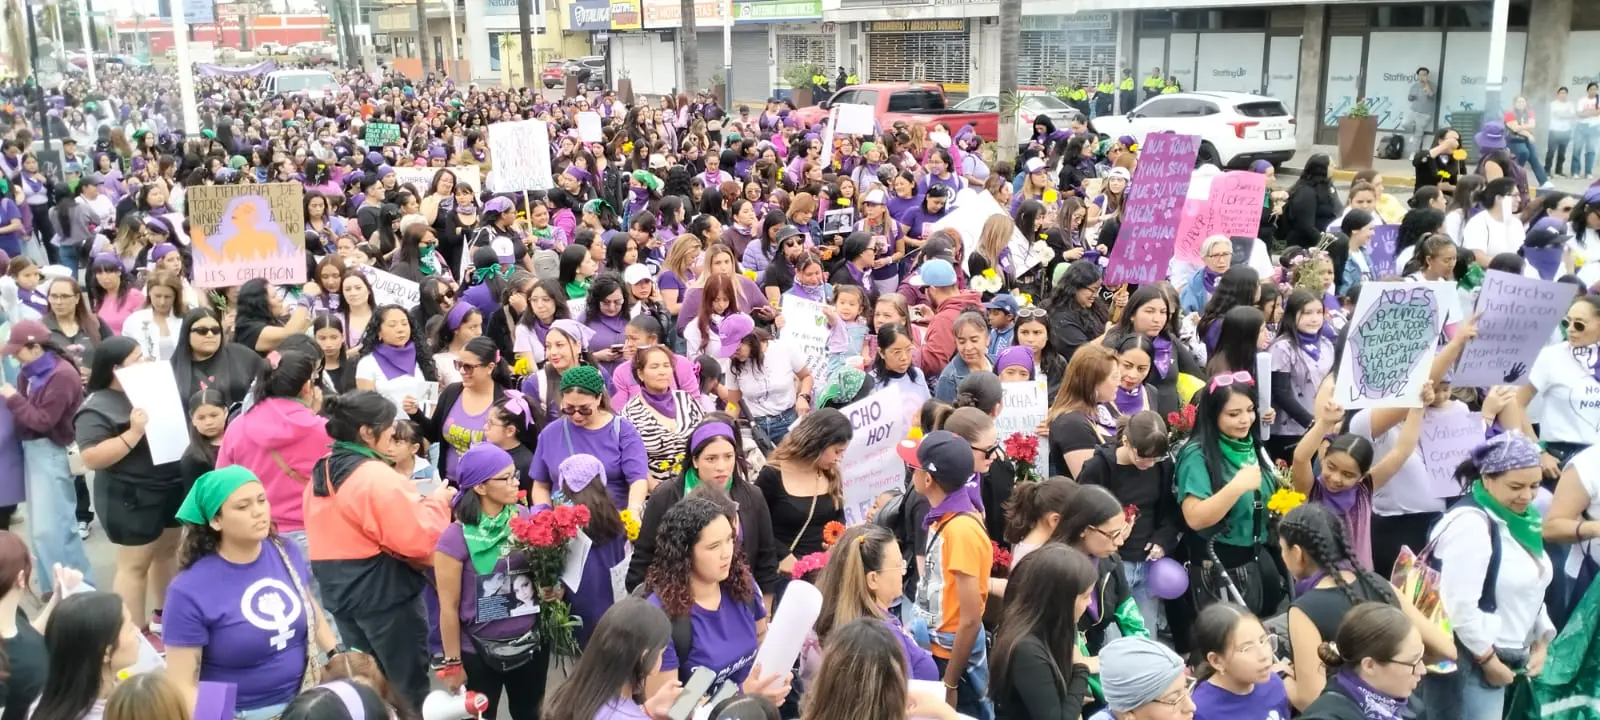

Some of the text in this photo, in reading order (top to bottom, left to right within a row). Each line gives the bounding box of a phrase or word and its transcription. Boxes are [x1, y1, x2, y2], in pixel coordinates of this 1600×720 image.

[660, 5, 713, 18] MOTOETAS
[192, 184, 296, 198] EN MEMORIA DE
[192, 197, 292, 210] TODAS LAS
[269, 212, 276, 222] A
[281, 211, 300, 222] LAS
[203, 222, 300, 237] QUE NO
[1379, 286, 1434, 307] NO ES
[1530, 305, 1557, 317] con
[1380, 320, 1399, 333] QUE
[1361, 323, 1424, 347] TENGAMOS
[1385, 352, 1414, 369] CUAL
[1350, 380, 1409, 402] LA VOZ
[866, 421, 894, 446] HOY
